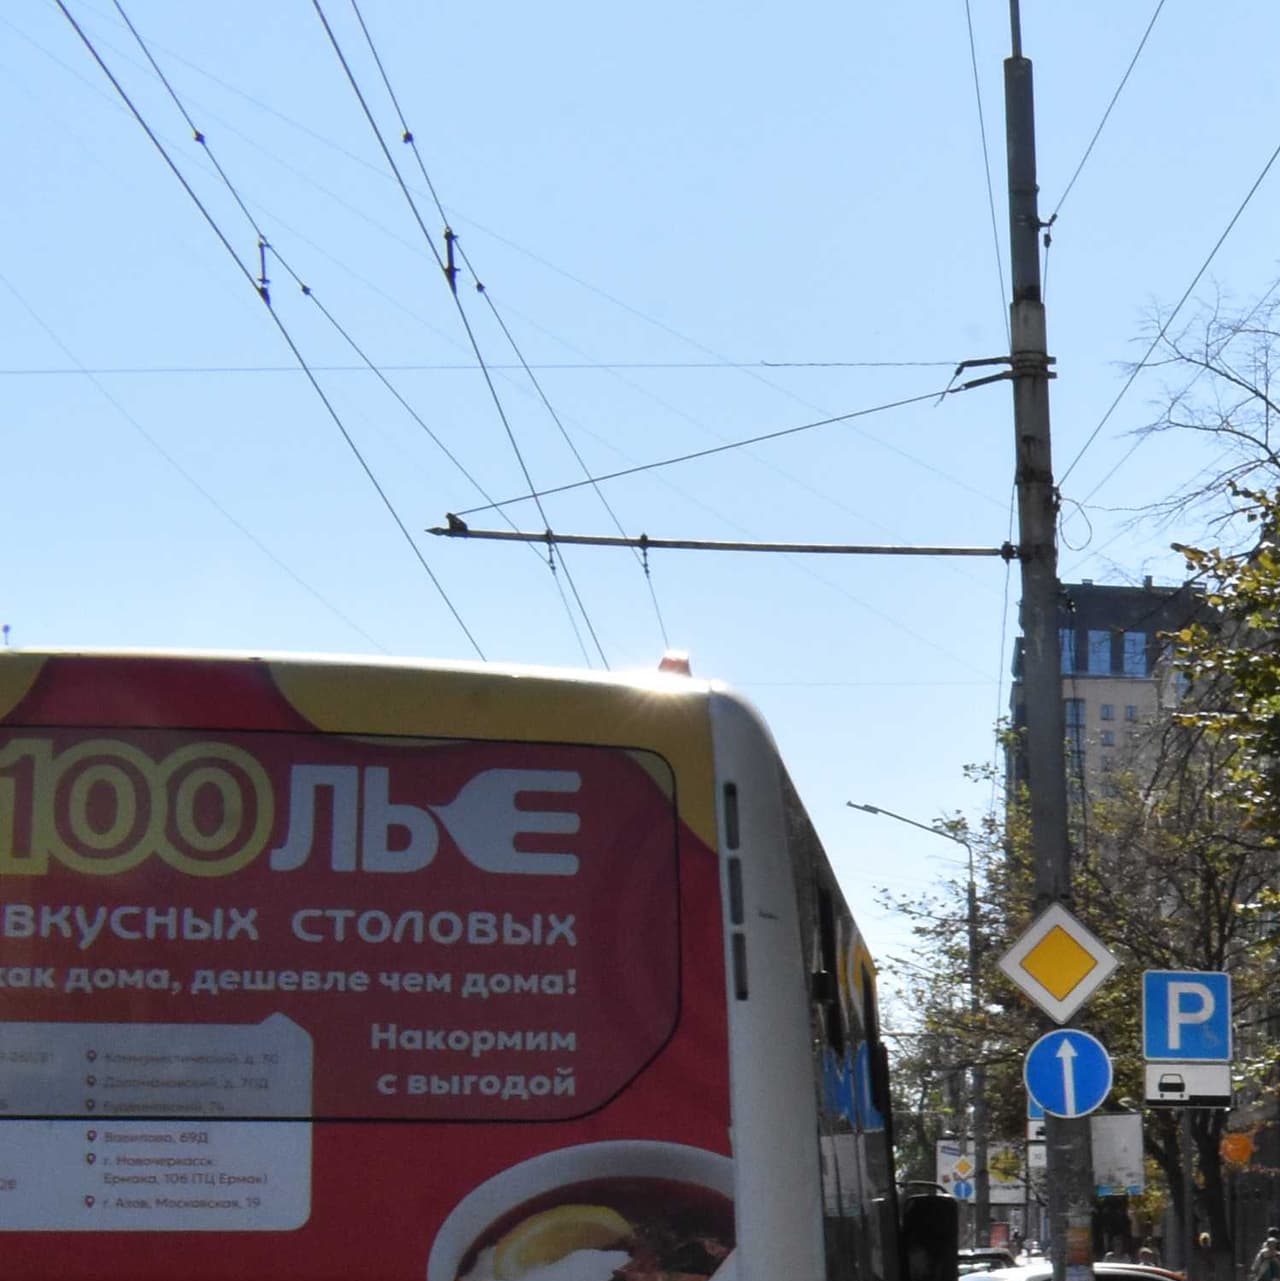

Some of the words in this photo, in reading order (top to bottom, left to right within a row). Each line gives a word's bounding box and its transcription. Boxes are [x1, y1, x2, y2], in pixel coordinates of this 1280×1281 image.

[0, 967, 54, 989] ак
[65, 967, 180, 995] дома,
[191, 967, 368, 995] дешевле
[378, 970, 451, 992] чем
[461, 969, 577, 998] дома!
[1168, 982, 1215, 1050] P
[371, 1022, 576, 1055] Накормим
[378, 1073, 398, 1094] с
[407, 1067, 576, 1100] выгодой
[164, 1174, 188, 1185] 106
